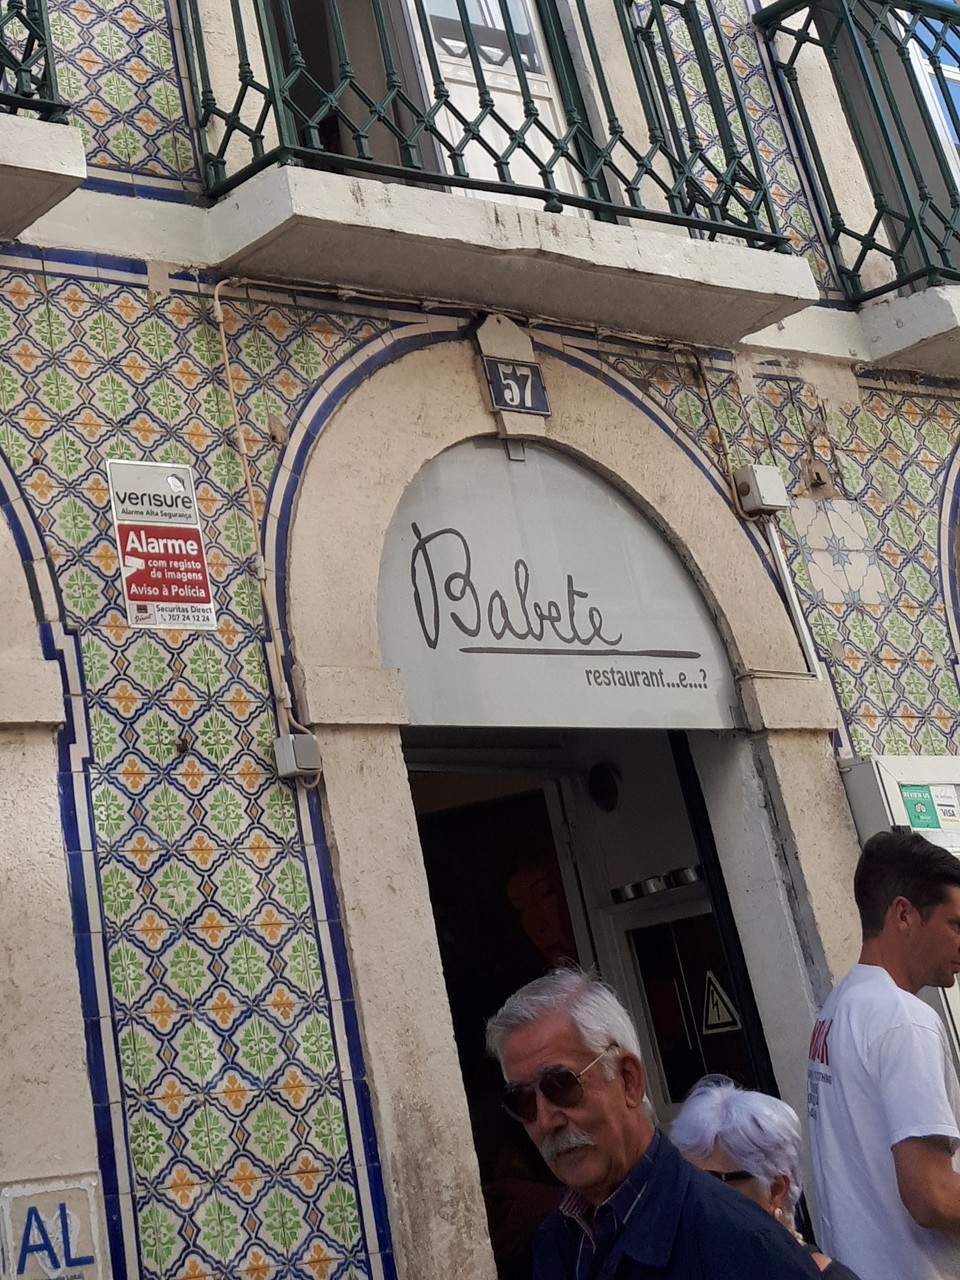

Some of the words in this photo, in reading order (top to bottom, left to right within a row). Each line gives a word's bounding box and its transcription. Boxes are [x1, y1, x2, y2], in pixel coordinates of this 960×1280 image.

[497, 363, 533, 408] 57
[115, 491, 193, 509] verisure
[121, 508, 144, 516] Alarme
[145, 509, 159, 517] Alta
[160, 510, 192, 519] Segurança
[125, 530, 199, 555] Alarme
[147, 559, 167, 568] com
[169, 559, 202, 571] registo
[150, 568, 162, 578] de
[164, 569, 203, 581] imagens
[130, 583, 160, 596] Aviso
[162, 584, 169, 596] à
[171, 584, 206, 597] Polícia
[411, 522, 623, 649] Babete
[156, 604, 189, 613] Securitas
[190, 605, 213, 614] Direct
[168, 613, 180, 621] 707
[940, 808, 957, 818] VISA
[16, 1202, 95, 1275] AL
